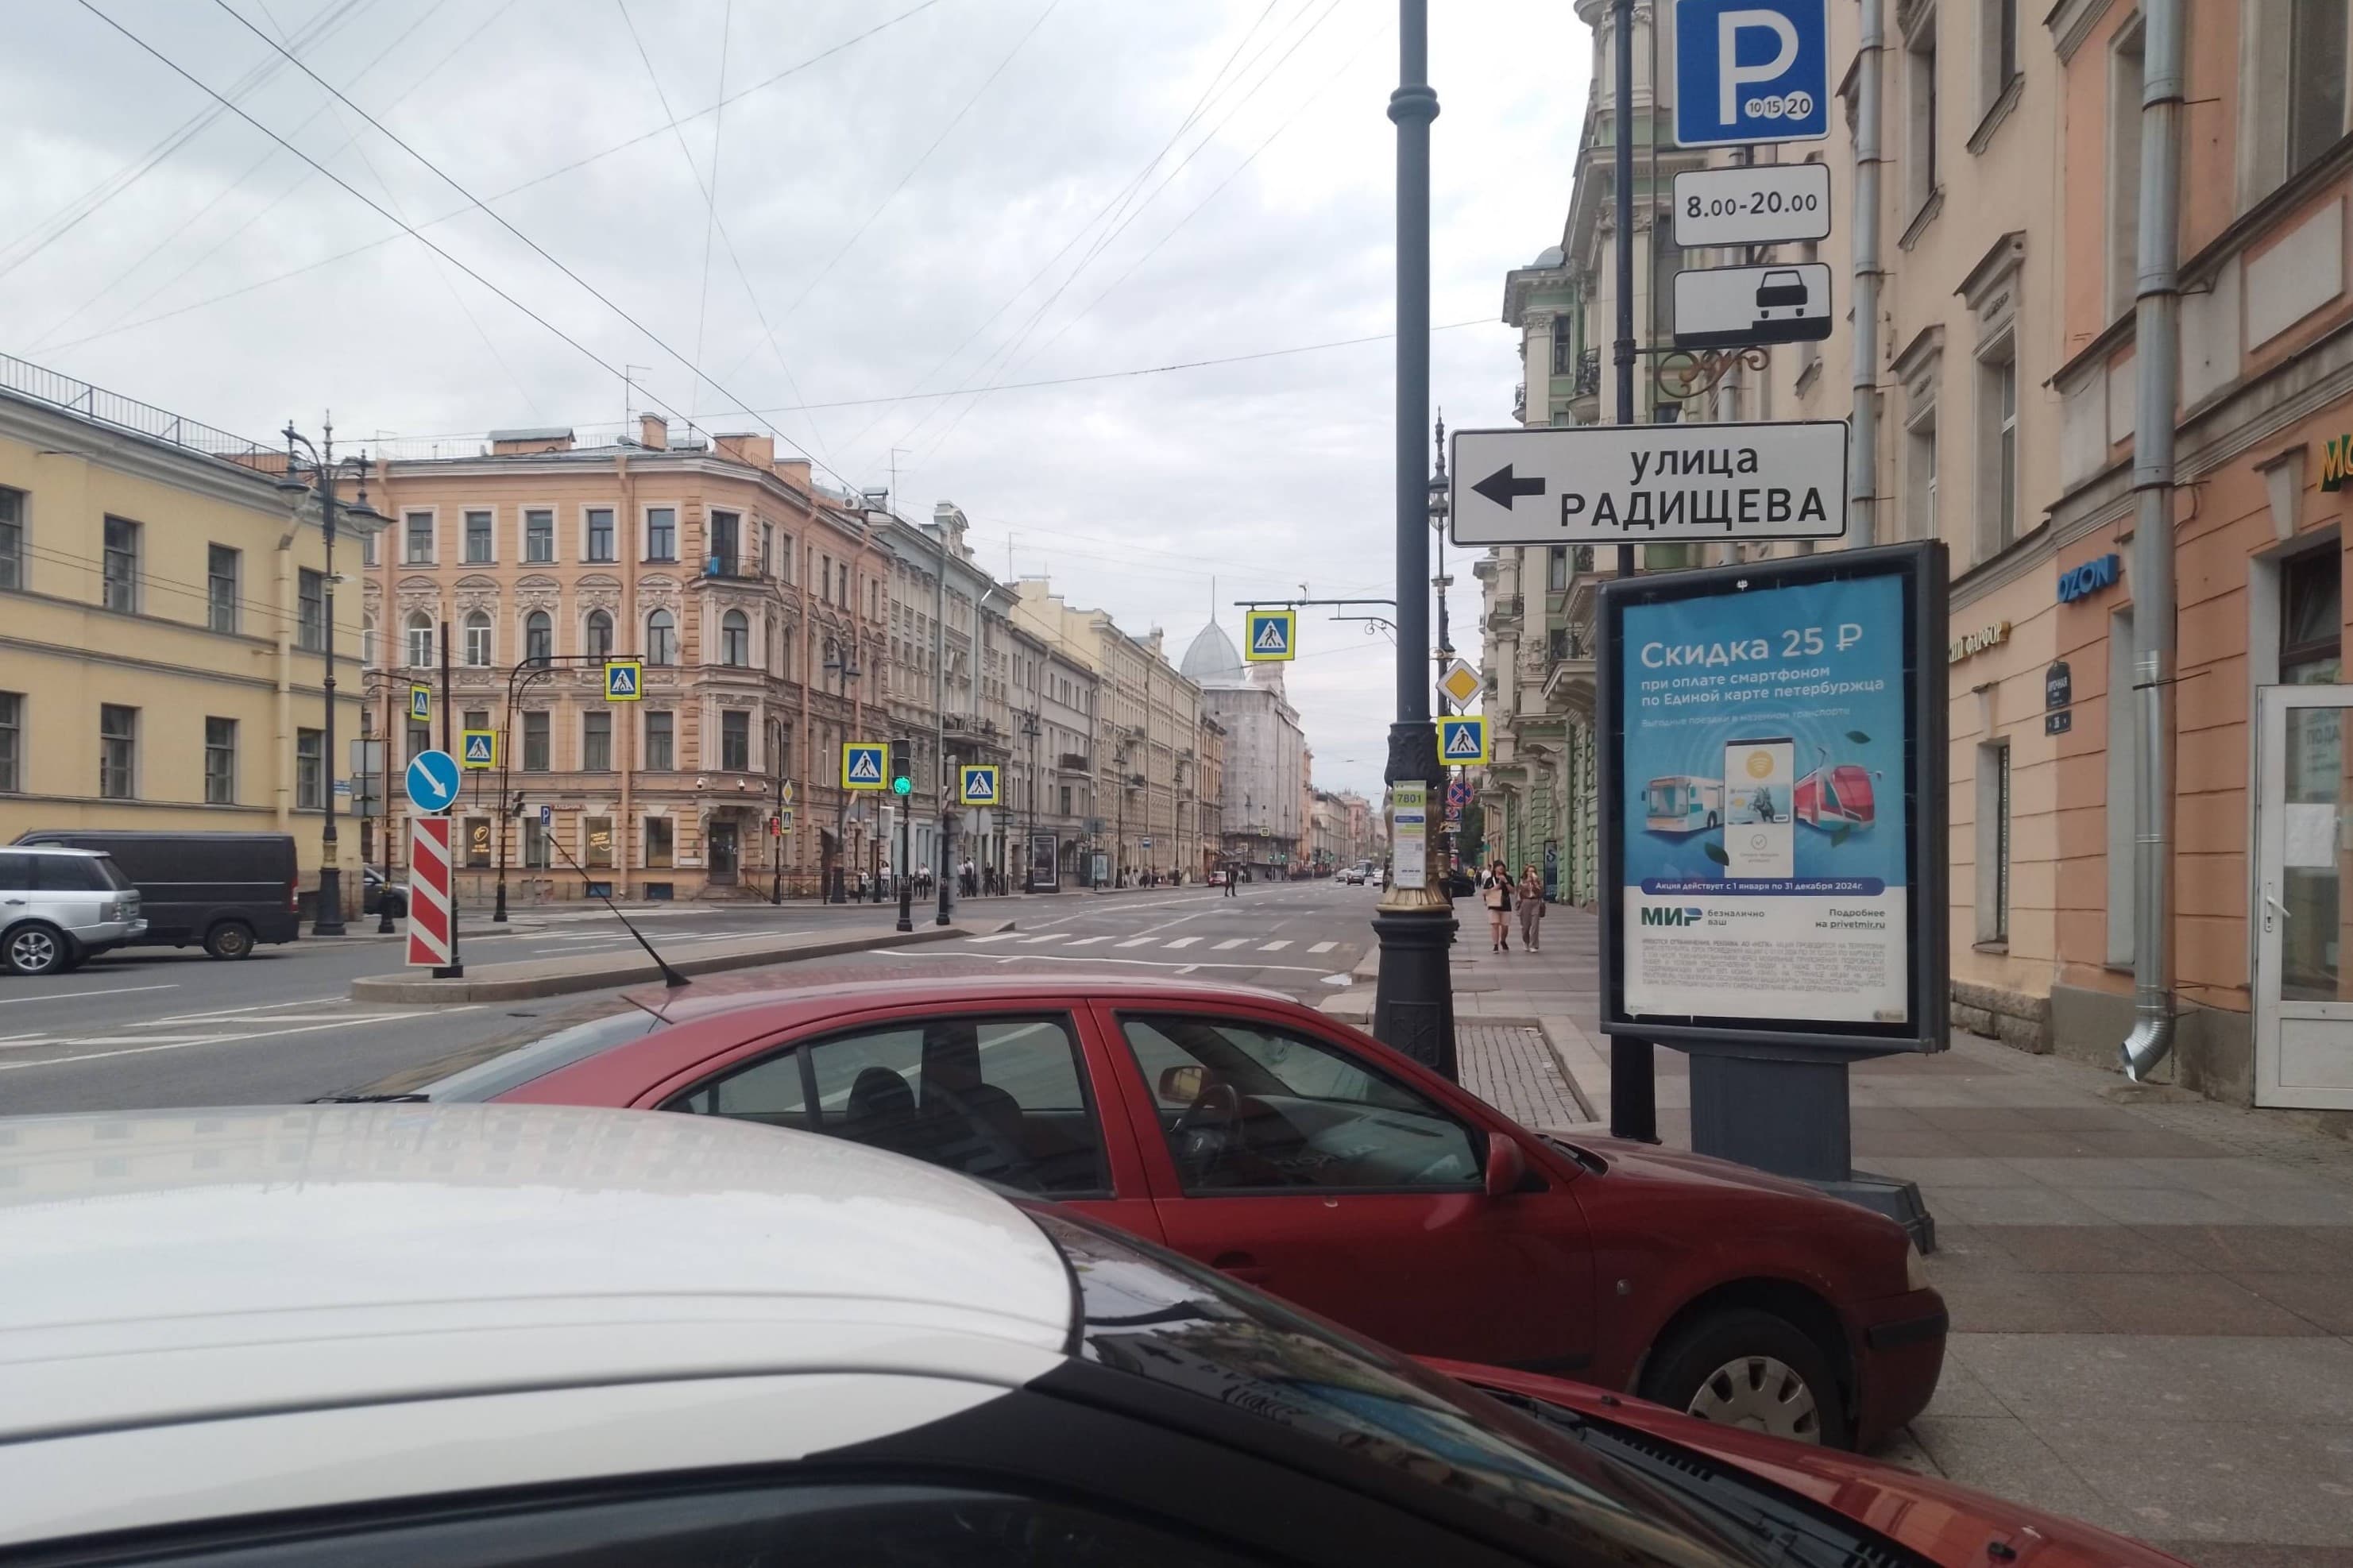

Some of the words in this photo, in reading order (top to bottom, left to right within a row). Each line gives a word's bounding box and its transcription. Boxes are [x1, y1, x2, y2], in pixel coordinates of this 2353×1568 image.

[1719, 9, 1799, 125] P
[1749, 102, 1760, 112] 10
[1766, 100, 1780, 114] 15
[1787, 98, 1810, 114] 20
[1687, 191, 1818, 218] 8.00-20.00
[1630, 447, 1758, 485] улица
[1560, 487, 1827, 531] РАДИЩЕВА
[2057, 555, 2115, 603] OZON
[1640, 638, 1769, 668] Скидка
[1781, 627, 1824, 657] 25
[1835, 623, 1863, 651] ₽
[1965, 623, 2002, 655] ФАРФОР
[1641, 679, 1669, 691] при
[1672, 674, 1725, 689] оплате
[1730, 666, 1830, 685] смартфоном
[1642, 696, 1660, 706] по
[1664, 691, 1720, 705] Единой
[1725, 688, 1769, 703] карте
[1774, 678, 1885, 697] петербуржца
[1397, 794, 1422, 804] 7801
[1683, 882, 1724, 891] действует
[1795, 882, 1833, 891] декабря
[1640, 907, 1703, 926] МИР
[1708, 909, 1765, 918] безналично
[1829, 909, 1886, 917] Подробнее
[1829, 920, 1886, 930] privetmir.ru
